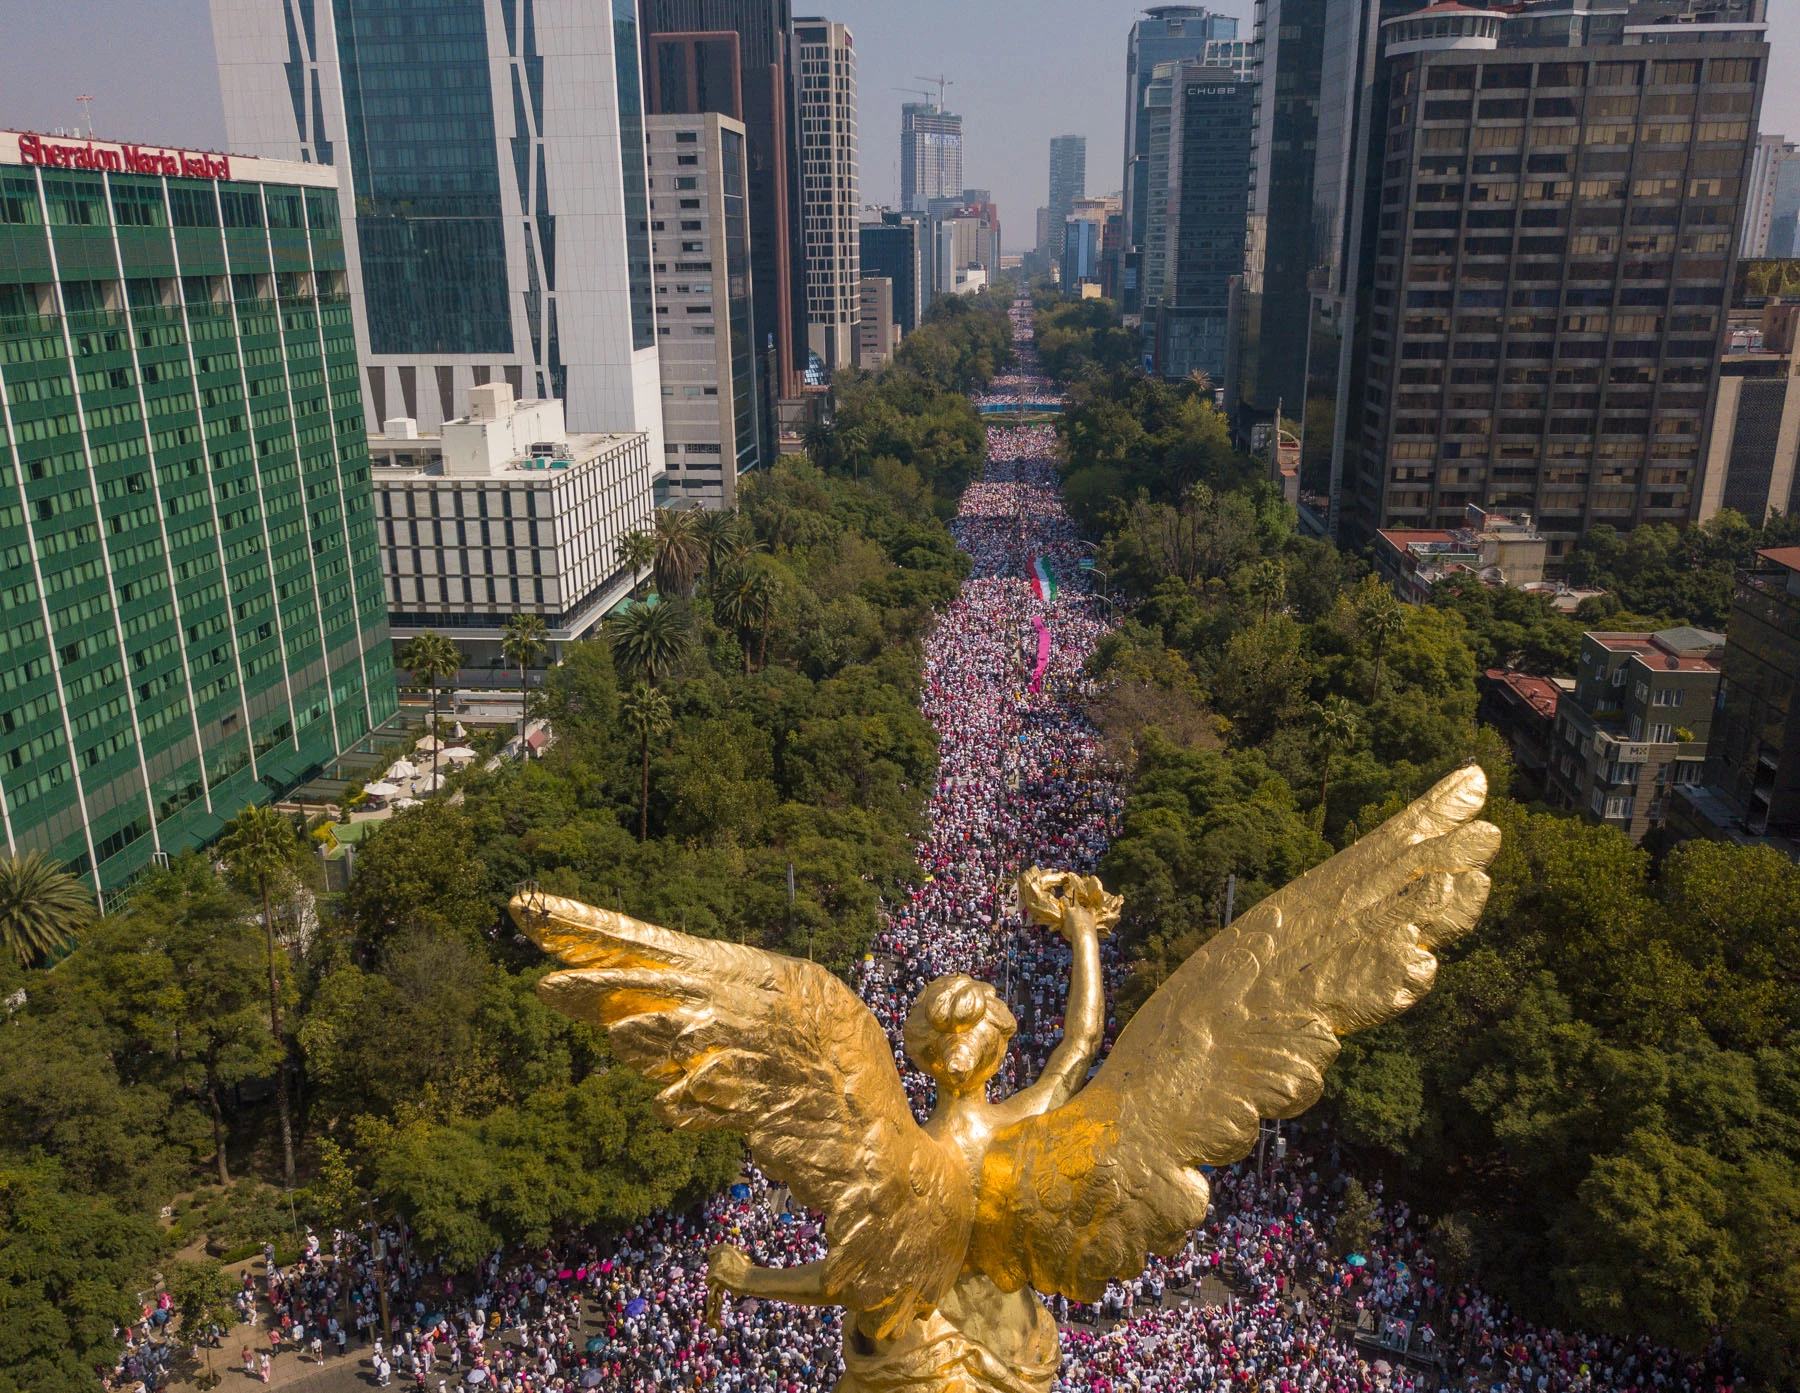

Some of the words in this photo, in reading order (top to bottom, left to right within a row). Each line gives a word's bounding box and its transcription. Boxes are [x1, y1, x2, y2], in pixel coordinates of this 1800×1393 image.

[1187, 87, 1236, 95] CHUBB
[18, 134, 122, 171] Sheraton
[121, 144, 179, 176] Maria
[179, 151, 232, 180] Isabel
